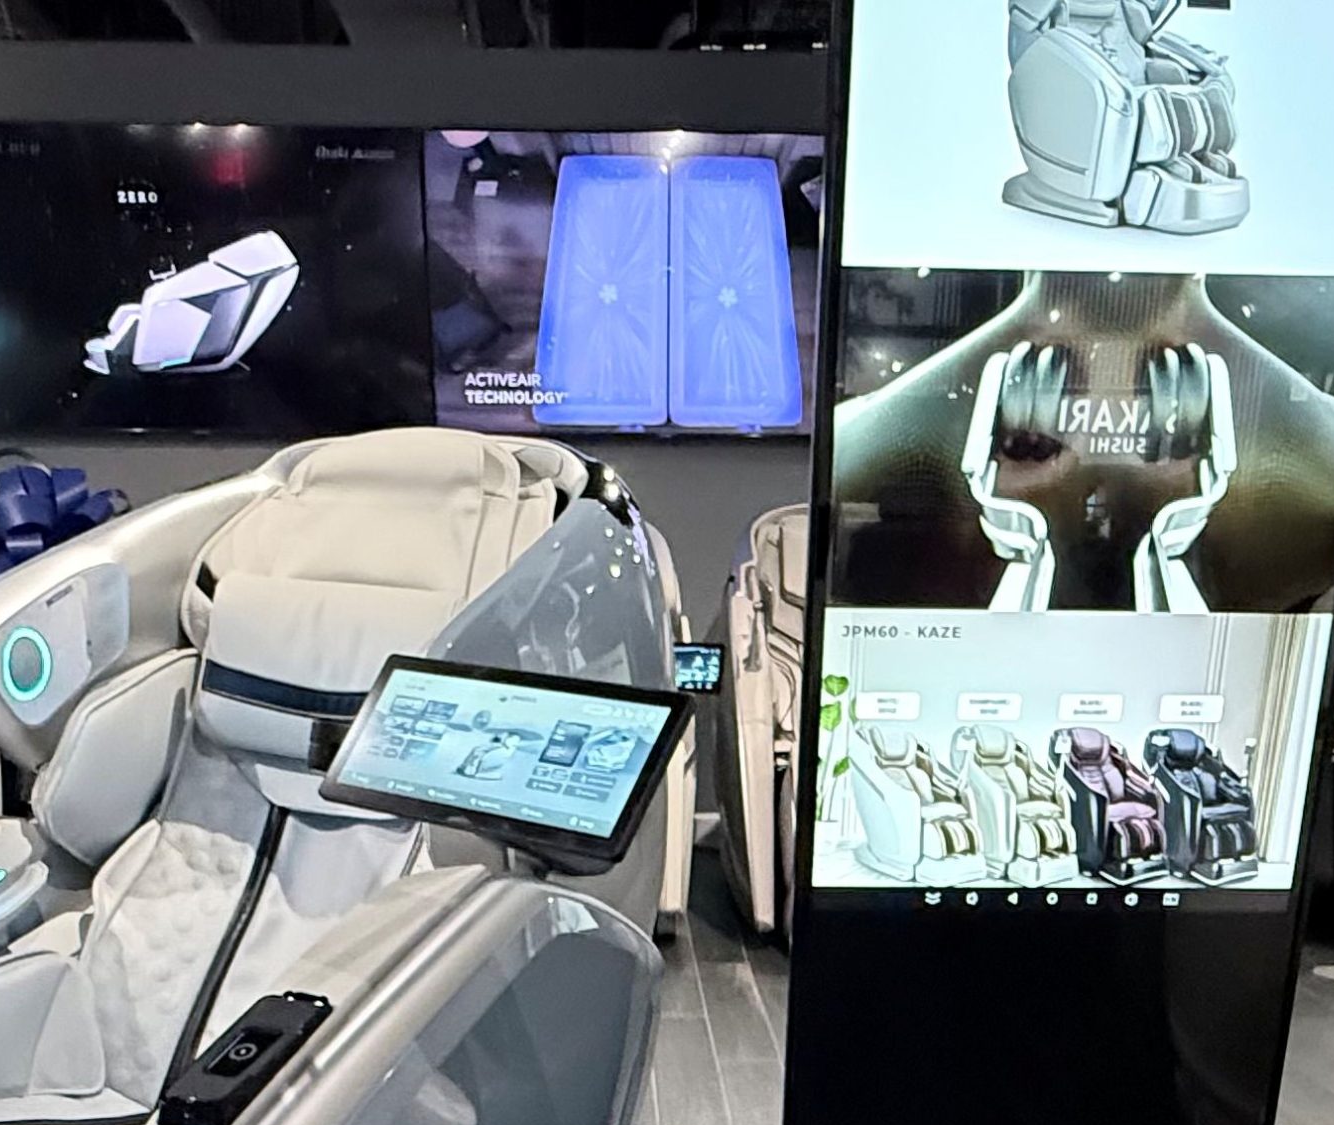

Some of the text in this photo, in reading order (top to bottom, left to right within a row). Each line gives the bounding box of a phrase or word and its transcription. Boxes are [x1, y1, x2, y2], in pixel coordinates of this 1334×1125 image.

[465, 372, 542, 387] ACTIVEAIR
[841, 625, 899, 638] JPM60
[917, 626, 962, 638] KAZE
